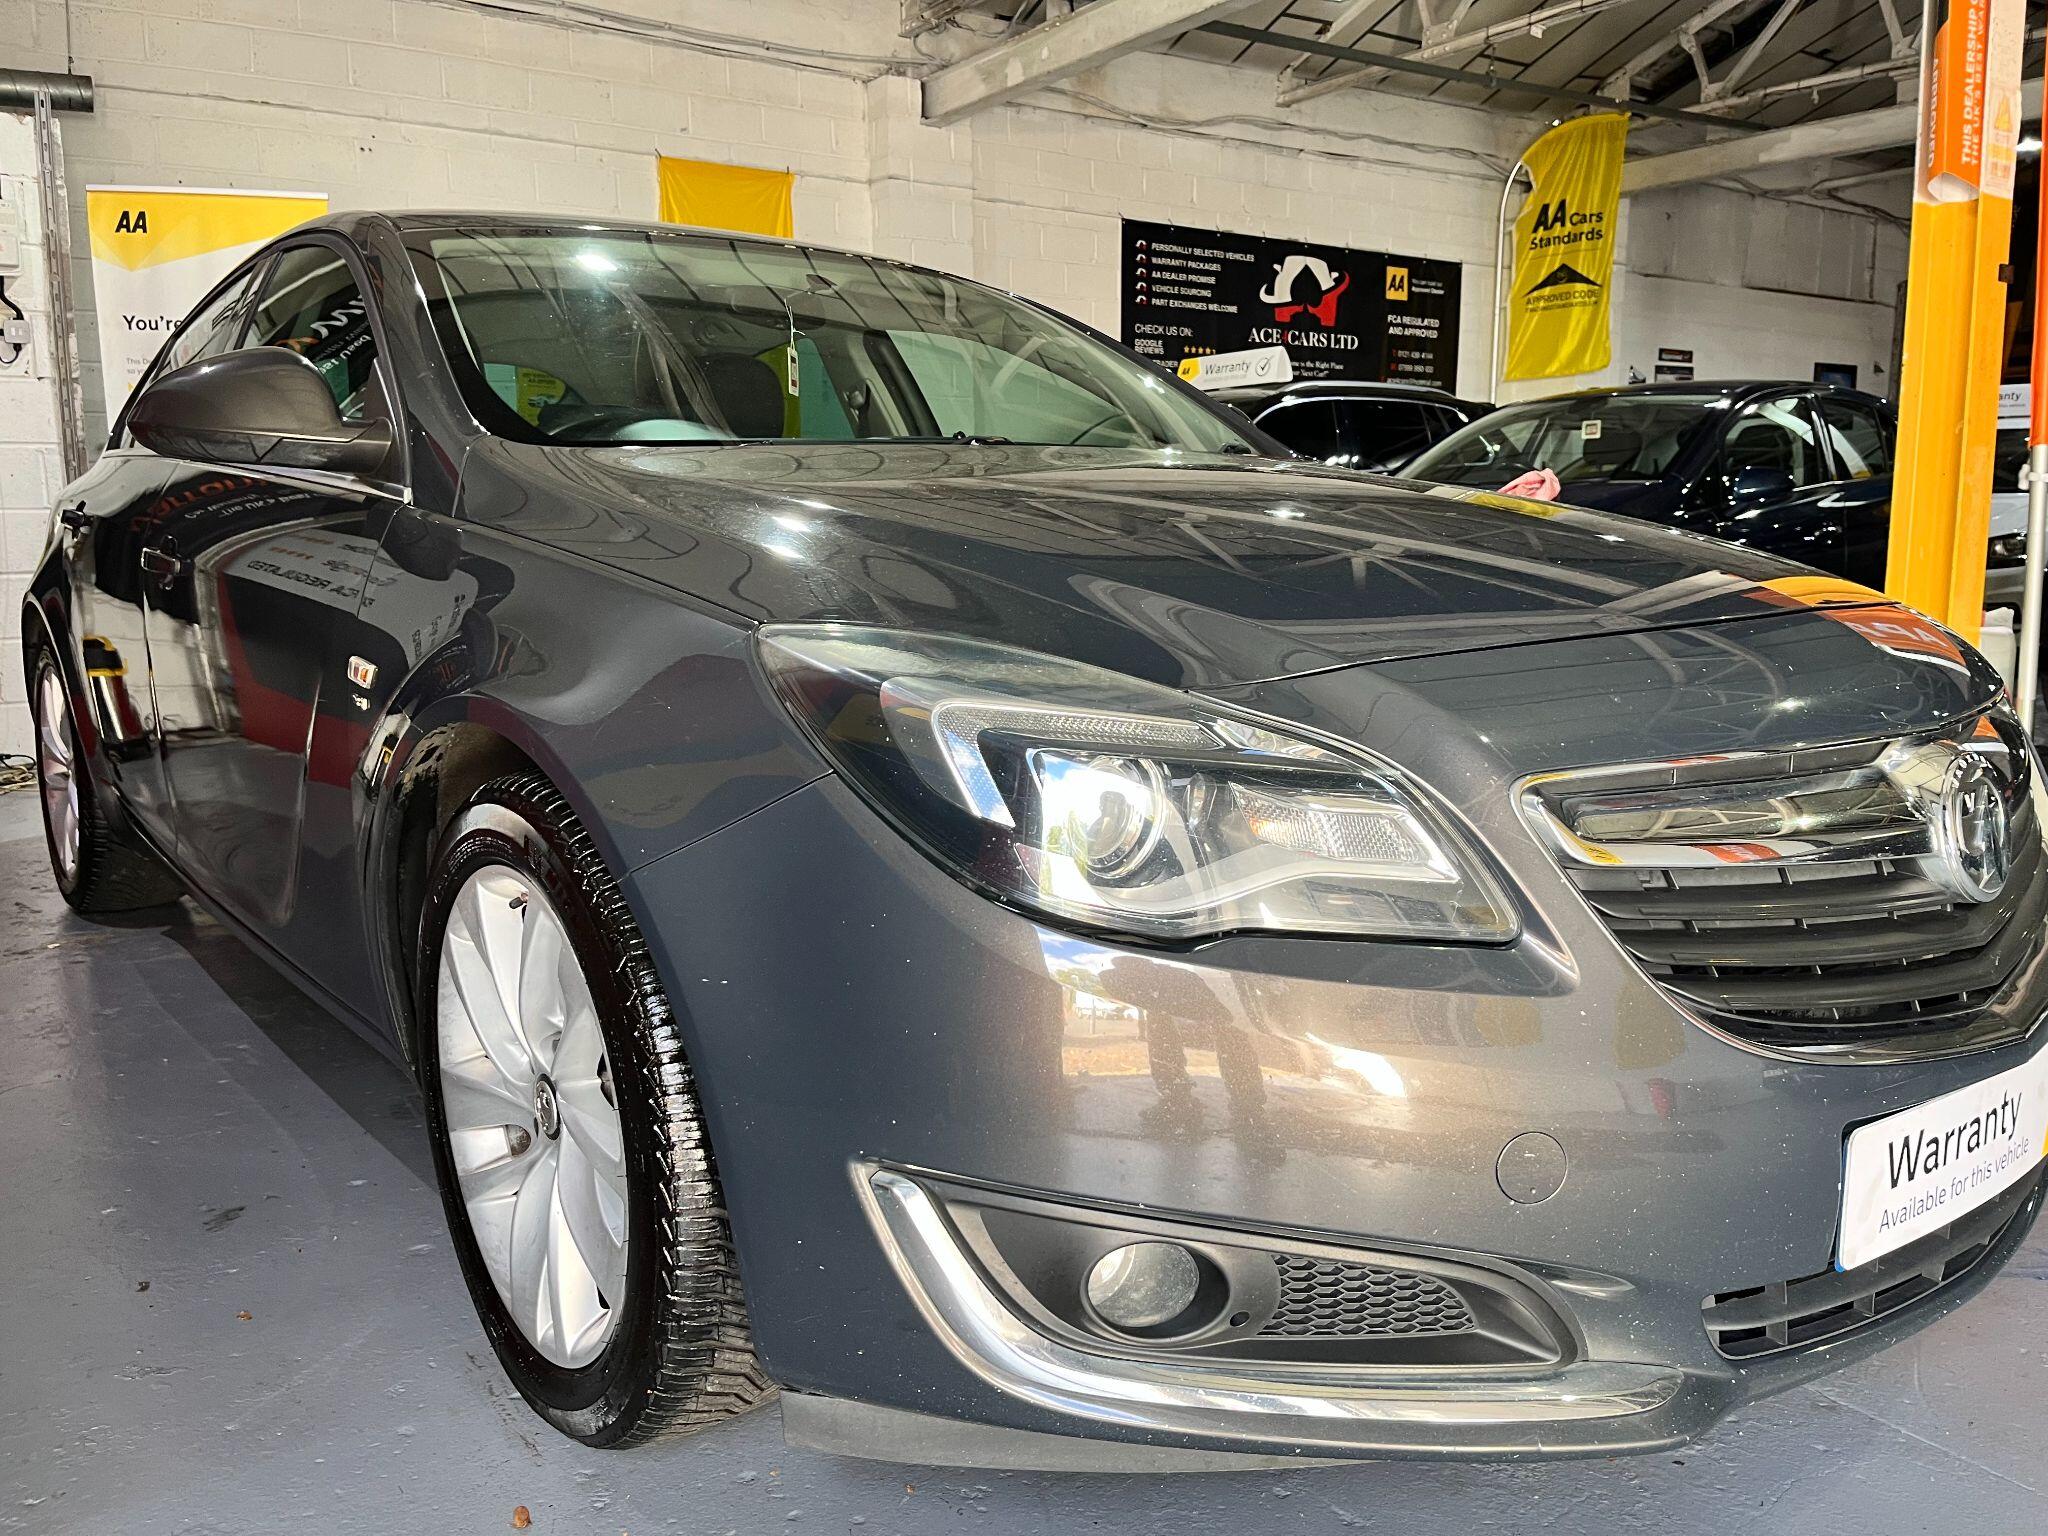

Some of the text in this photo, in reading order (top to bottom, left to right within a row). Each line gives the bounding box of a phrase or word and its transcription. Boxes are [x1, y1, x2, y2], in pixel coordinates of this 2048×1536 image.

[1963, 10, 1978, 120] DEALERSHIP
[1961, 124, 1973, 165] THIS
[1971, 133, 1980, 166] THE
[115, 210, 148, 234] AA
[1531, 198, 1603, 234] AA Cars
[1529, 227, 1603, 251] Standards
[1151, 242, 1255, 262] PERSONALLY SELECTED VEHICLES
[1151, 256, 1221, 271] WARRANTY PACKAGES
[1152, 270, 1216, 284] AA DEALER PROMISE
[1388, 274, 1405, 292] AA
[1152, 284, 1212, 297] VEHICLE SOURCING
[1573, 288, 1600, 300] CODE
[1151, 298, 1238, 313] PART EXCHANGES WELCOME
[1387, 314, 1440, 328] FCA REGULATED
[1134, 323, 1165, 335] CHECK
[1165, 325, 1178, 336] US
[1388, 326, 1438, 339] AND APPROVED
[1134, 338, 1163, 348] GOOGLE
[1330, 333, 1359, 350] LTD
[1134, 345, 1165, 355] REVIEWS
[1205, 362, 1250, 377] Warranty
[1888, 1089, 2023, 1190] Warranty
[1879, 1136, 2030, 1234] Available for this vehicle
